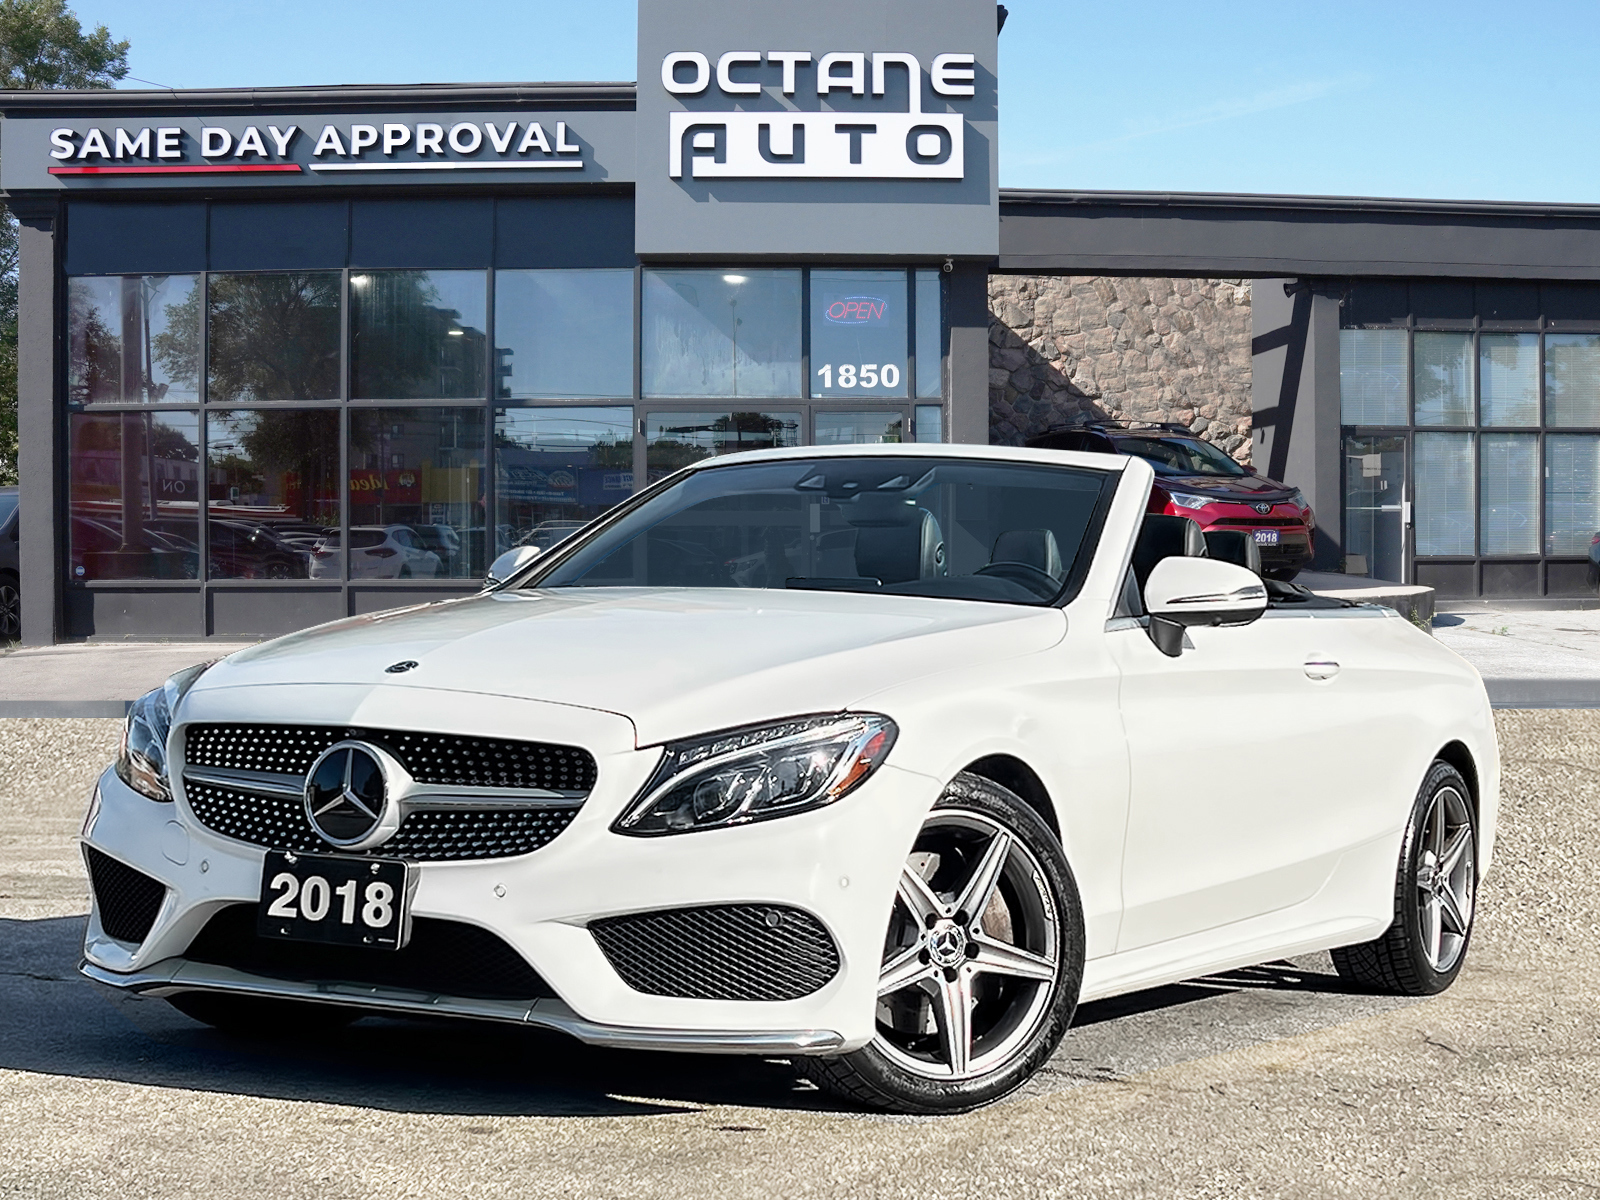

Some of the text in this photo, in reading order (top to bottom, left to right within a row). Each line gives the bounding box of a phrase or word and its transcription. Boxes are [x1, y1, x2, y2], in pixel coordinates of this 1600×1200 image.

[661, 51, 976, 100] OCTANE
[49, 121, 580, 159] SAME DAY APPROVAL
[680, 122, 953, 177] AUTO
[829, 301, 885, 319] OPEN
[817, 363, 900, 389] 1850
[1255, 532, 1278, 543] 2018
[267, 871, 395, 928] 2018
